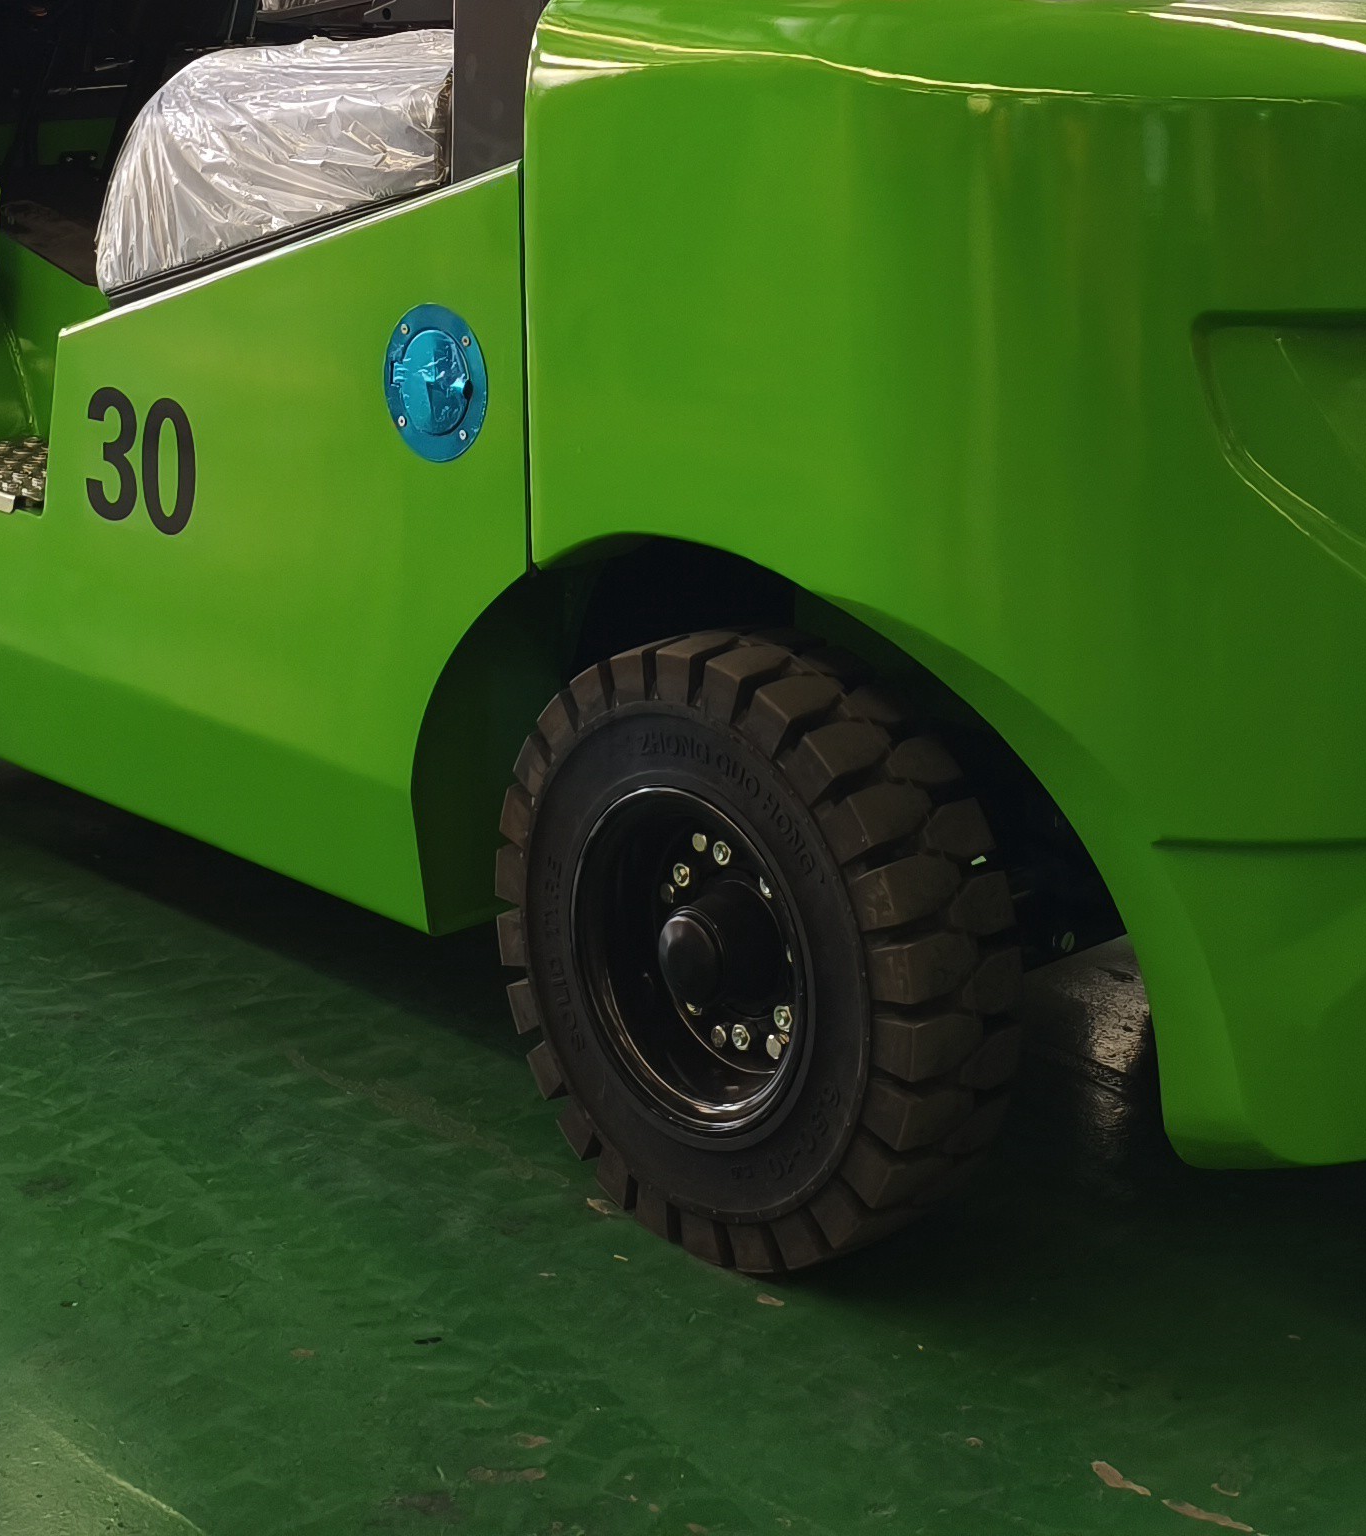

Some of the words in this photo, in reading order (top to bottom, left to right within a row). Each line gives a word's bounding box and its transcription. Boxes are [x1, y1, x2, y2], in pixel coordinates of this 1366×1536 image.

[85, 386, 196, 535] 30
[639, 732, 710, 766] ZHONG
[716, 753, 761, 798] GUO
[762, 793, 818, 878] HONG
[549, 956, 586, 1055] SOLID
